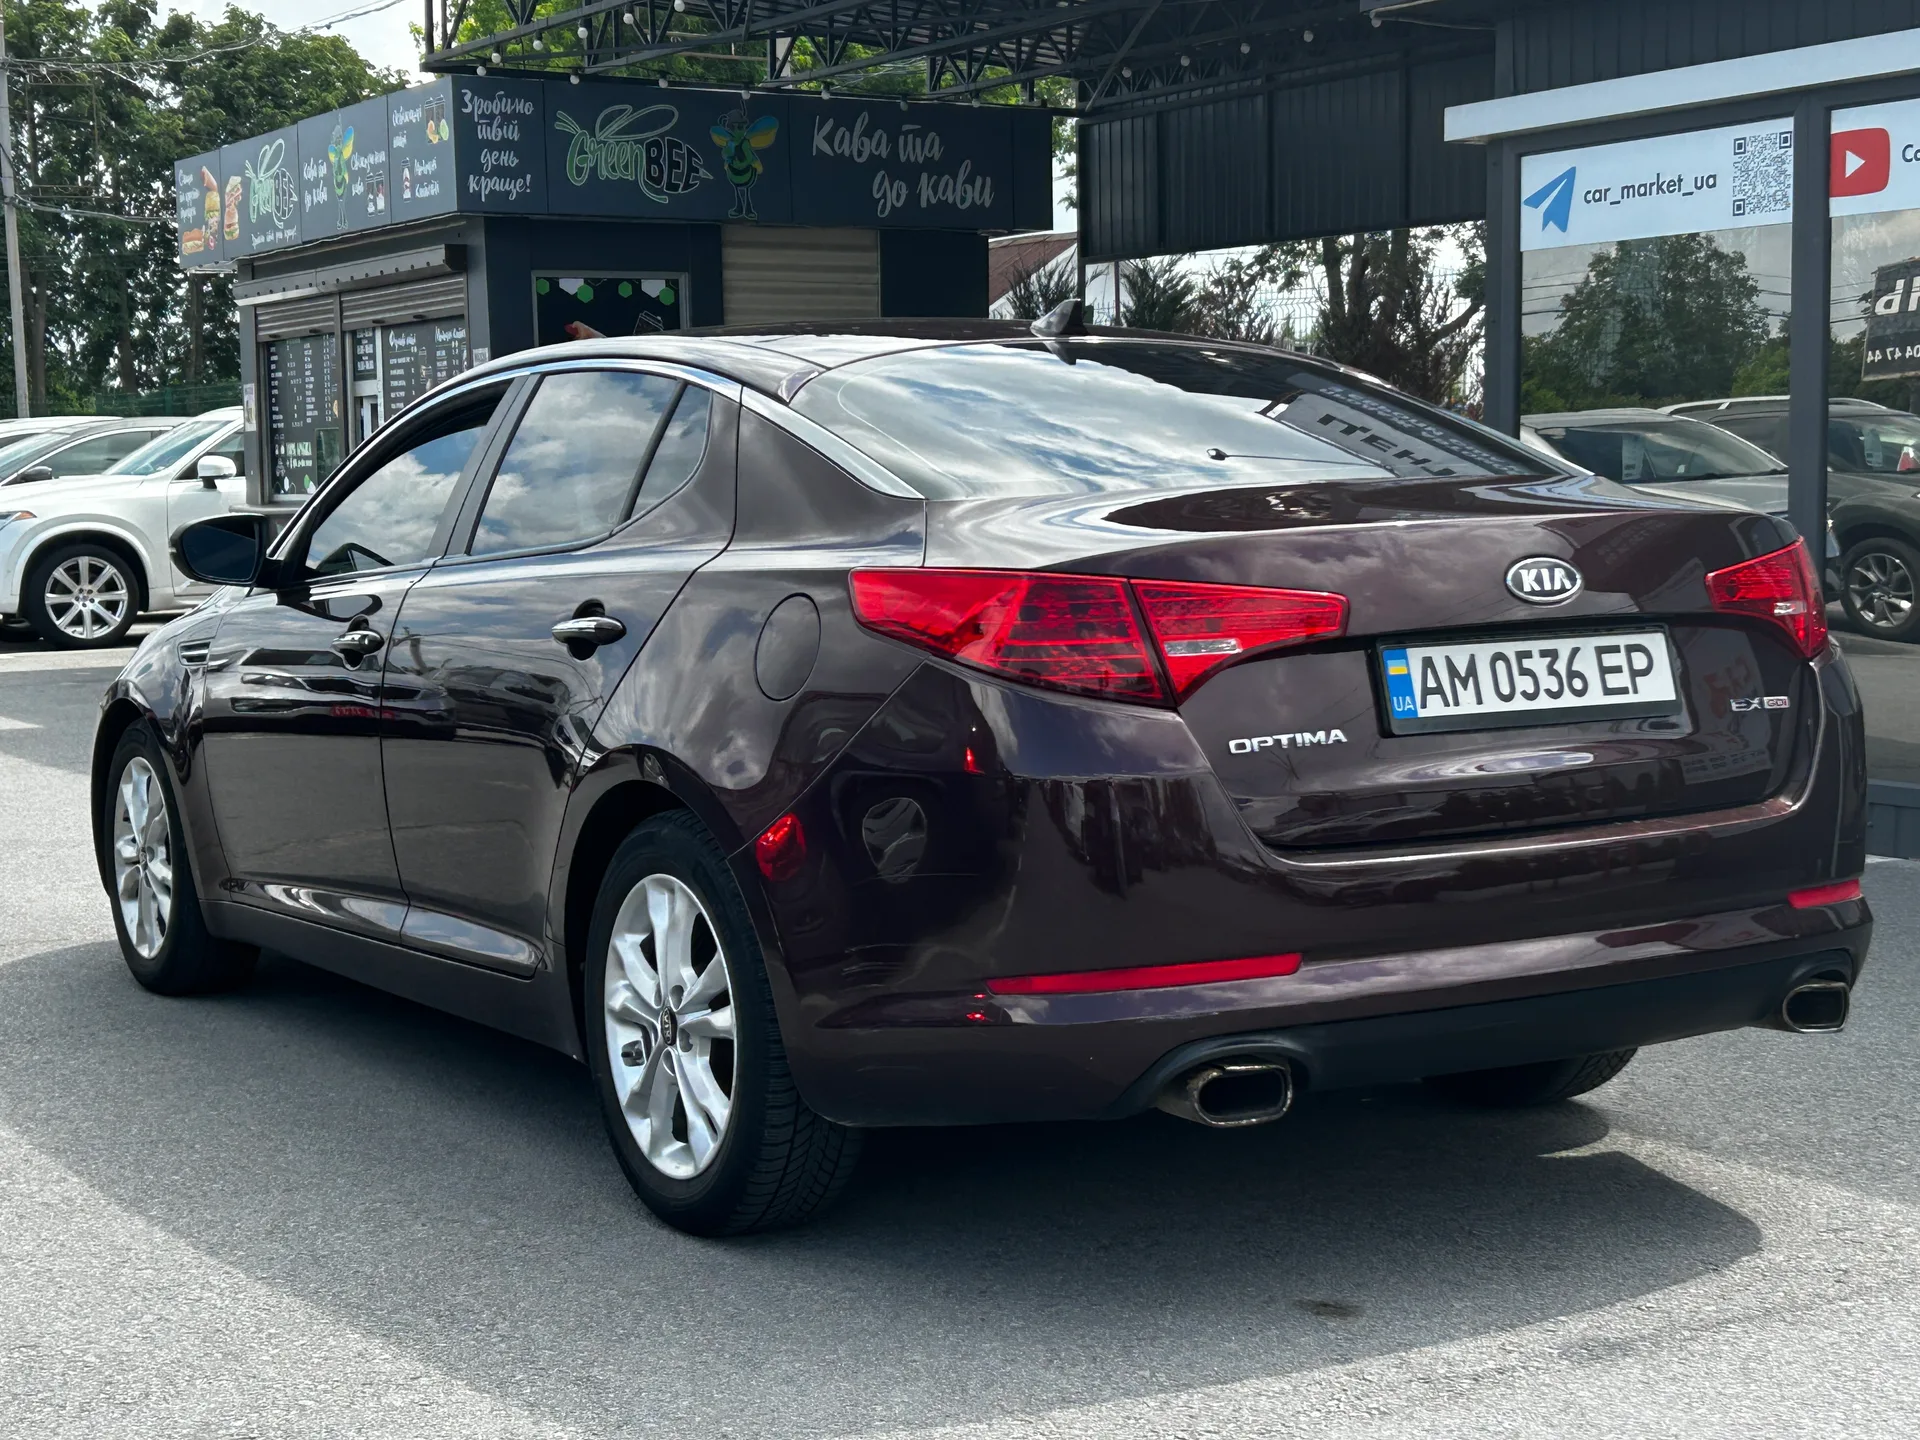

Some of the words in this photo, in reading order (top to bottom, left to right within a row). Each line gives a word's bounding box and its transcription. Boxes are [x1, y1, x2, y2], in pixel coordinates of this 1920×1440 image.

[461, 89, 534, 122] Зробимо
[477, 111, 520, 141] твій
[812, 111, 892, 164] Кава
[899, 124, 945, 164] та
[480, 148, 520, 173] день
[467, 174, 532, 202] краще!
[872, 169, 909, 218] до
[916, 159, 995, 210] кави
[1583, 172, 1717, 206] car_market_ua
[1518, 567, 1572, 592] KIA
[1420, 653, 1484, 709] AM
[1489, 646, 1589, 703] 0536
[1594, 643, 1654, 696] EP
[1393, 696, 1414, 712] UA
[1730, 697, 1761, 711] EX
[1228, 729, 1348, 754] OPTIMA
